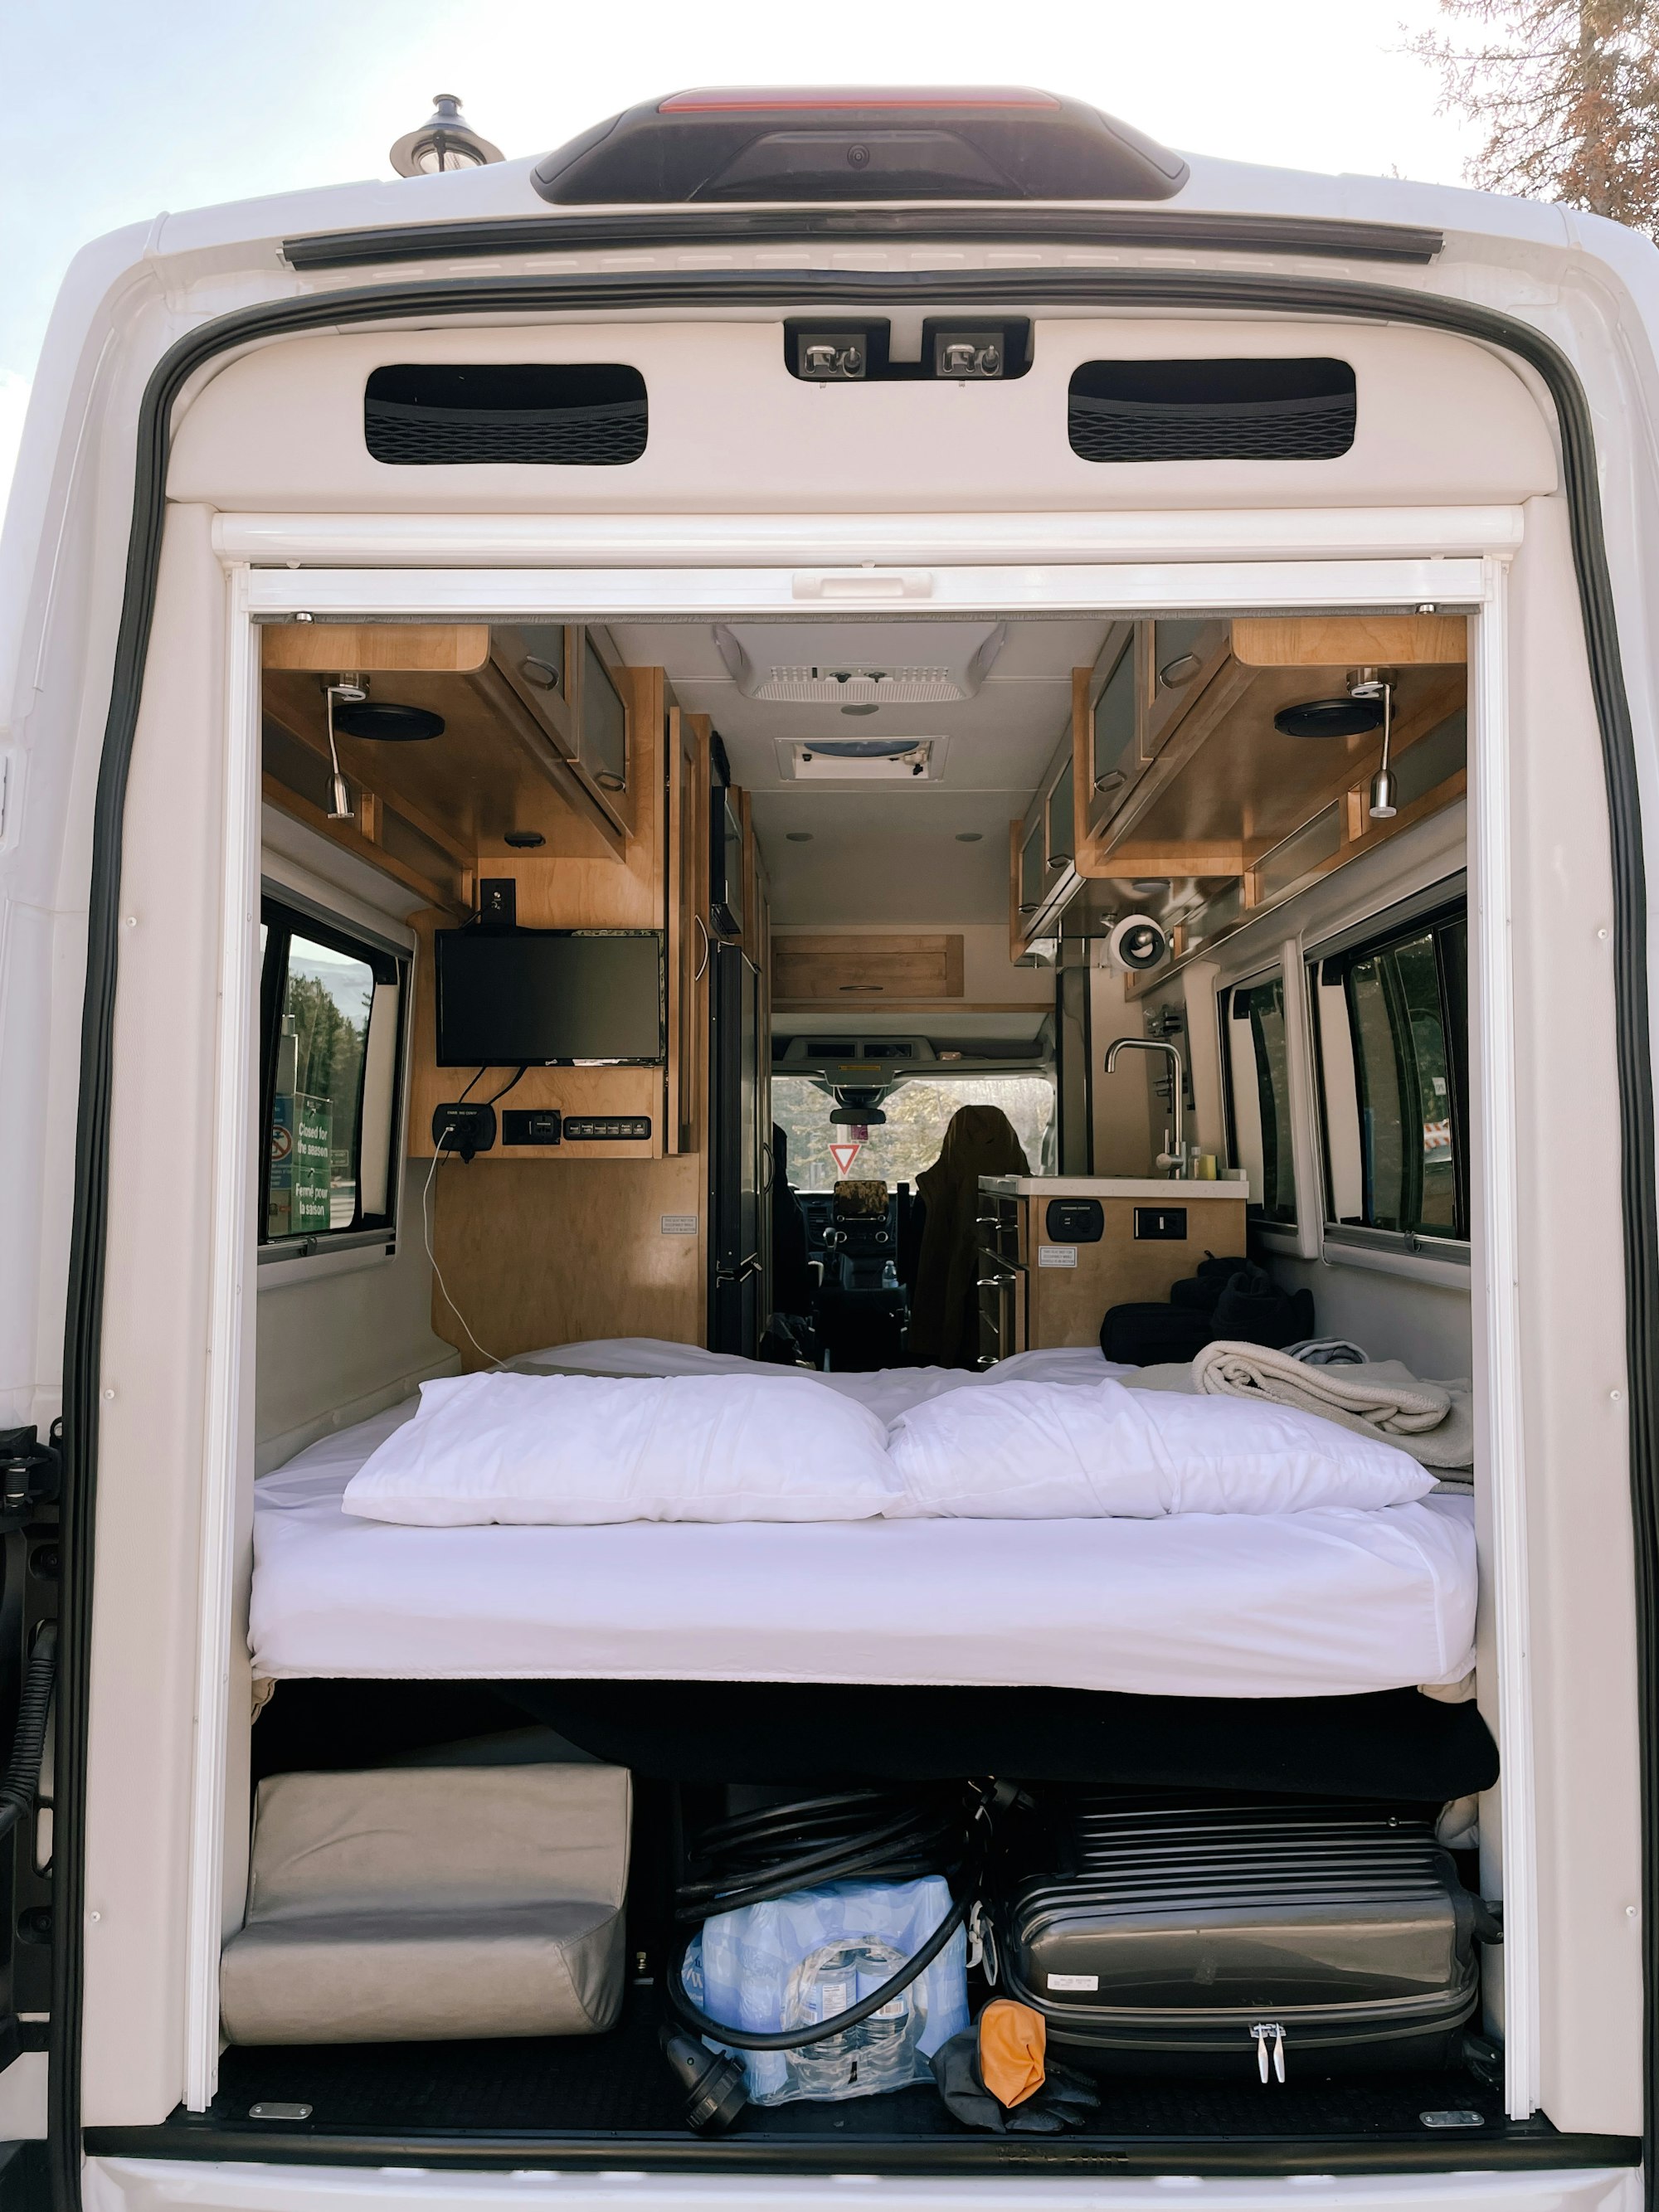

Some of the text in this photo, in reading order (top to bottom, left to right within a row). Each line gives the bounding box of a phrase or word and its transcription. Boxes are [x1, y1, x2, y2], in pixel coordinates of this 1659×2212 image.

[299, 1122, 328, 1140] Closed for
[297, 1140, 328, 1158] the season
[295, 1183, 328, 1201] Fermé pour
[299, 1200, 325, 1216] la saison
